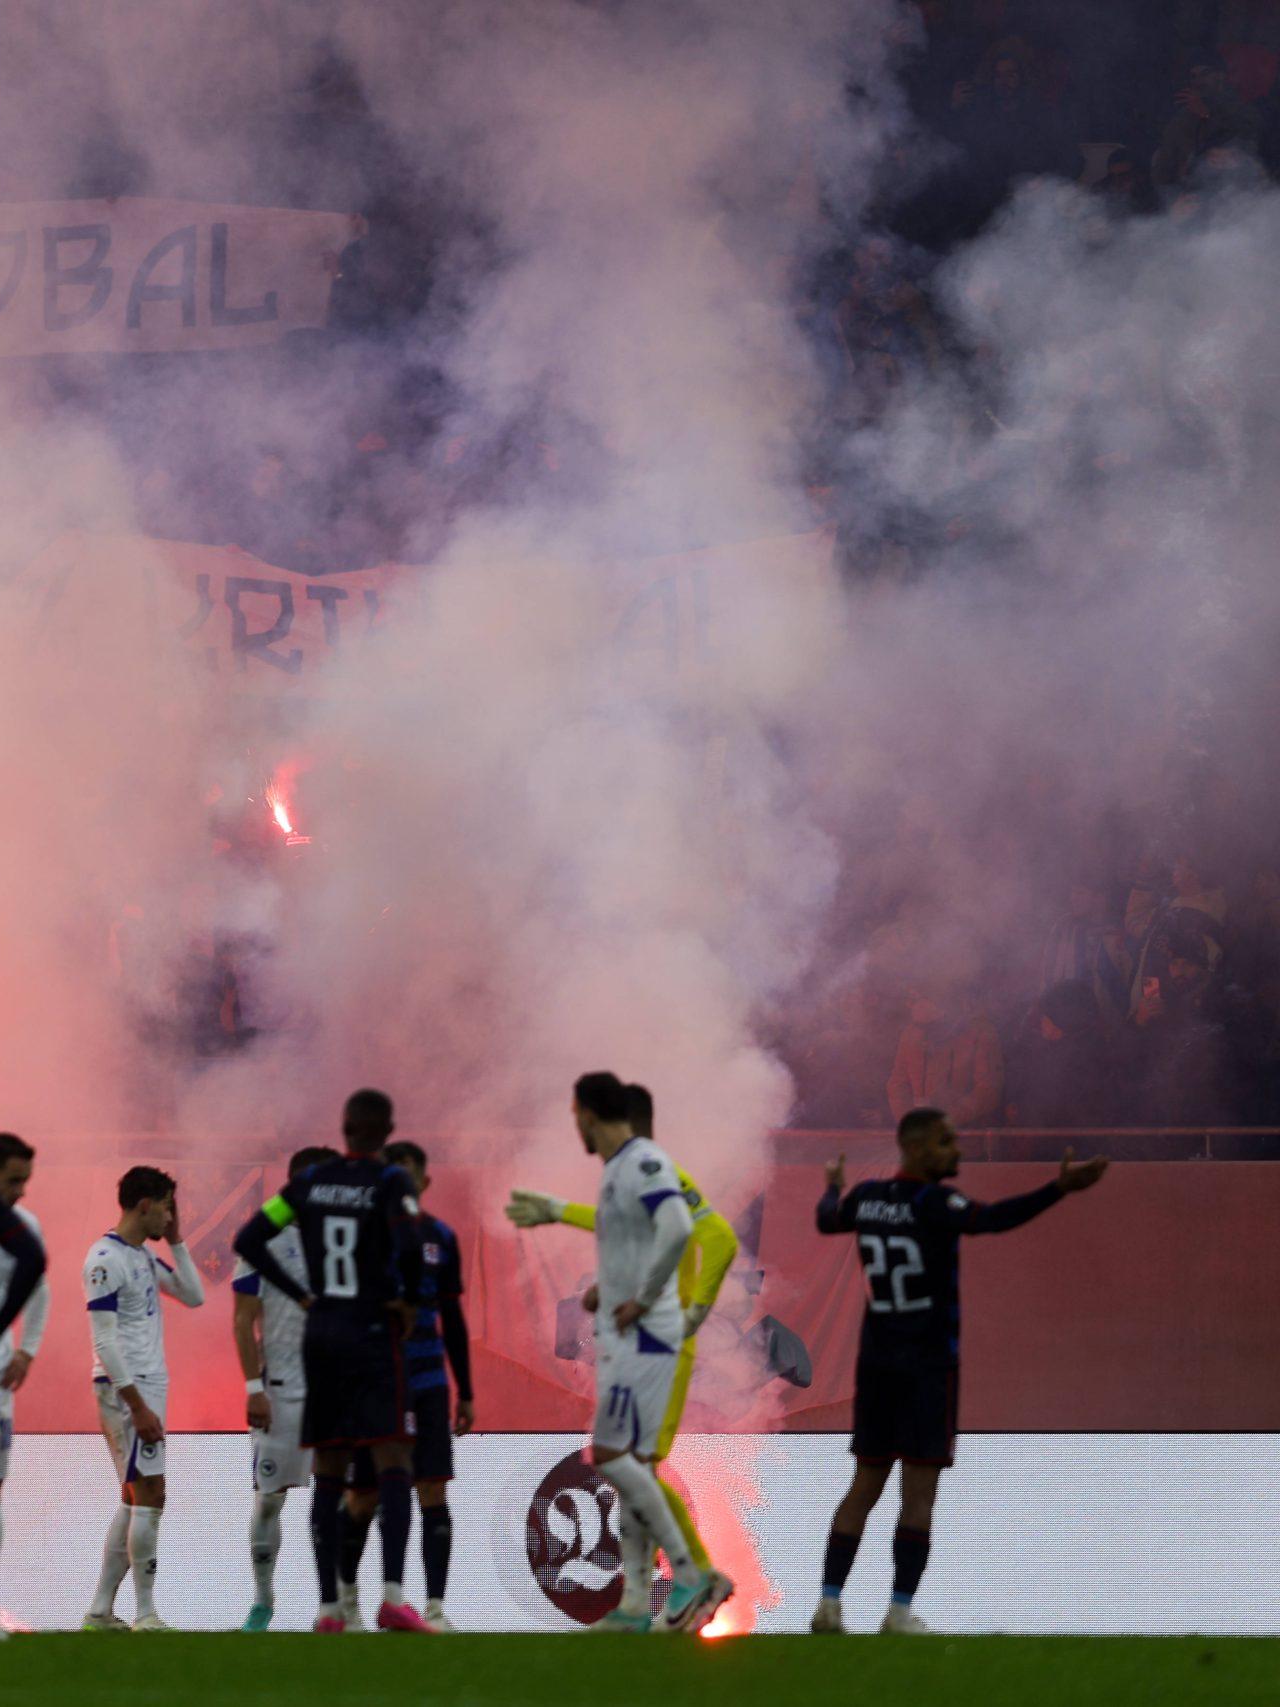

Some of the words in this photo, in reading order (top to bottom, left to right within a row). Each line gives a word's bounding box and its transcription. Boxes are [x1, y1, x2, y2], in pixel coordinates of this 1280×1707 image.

[323, 1215, 358, 1297] 8
[860, 1235, 933, 1313] 22
[608, 1385, 631, 1418] 11
